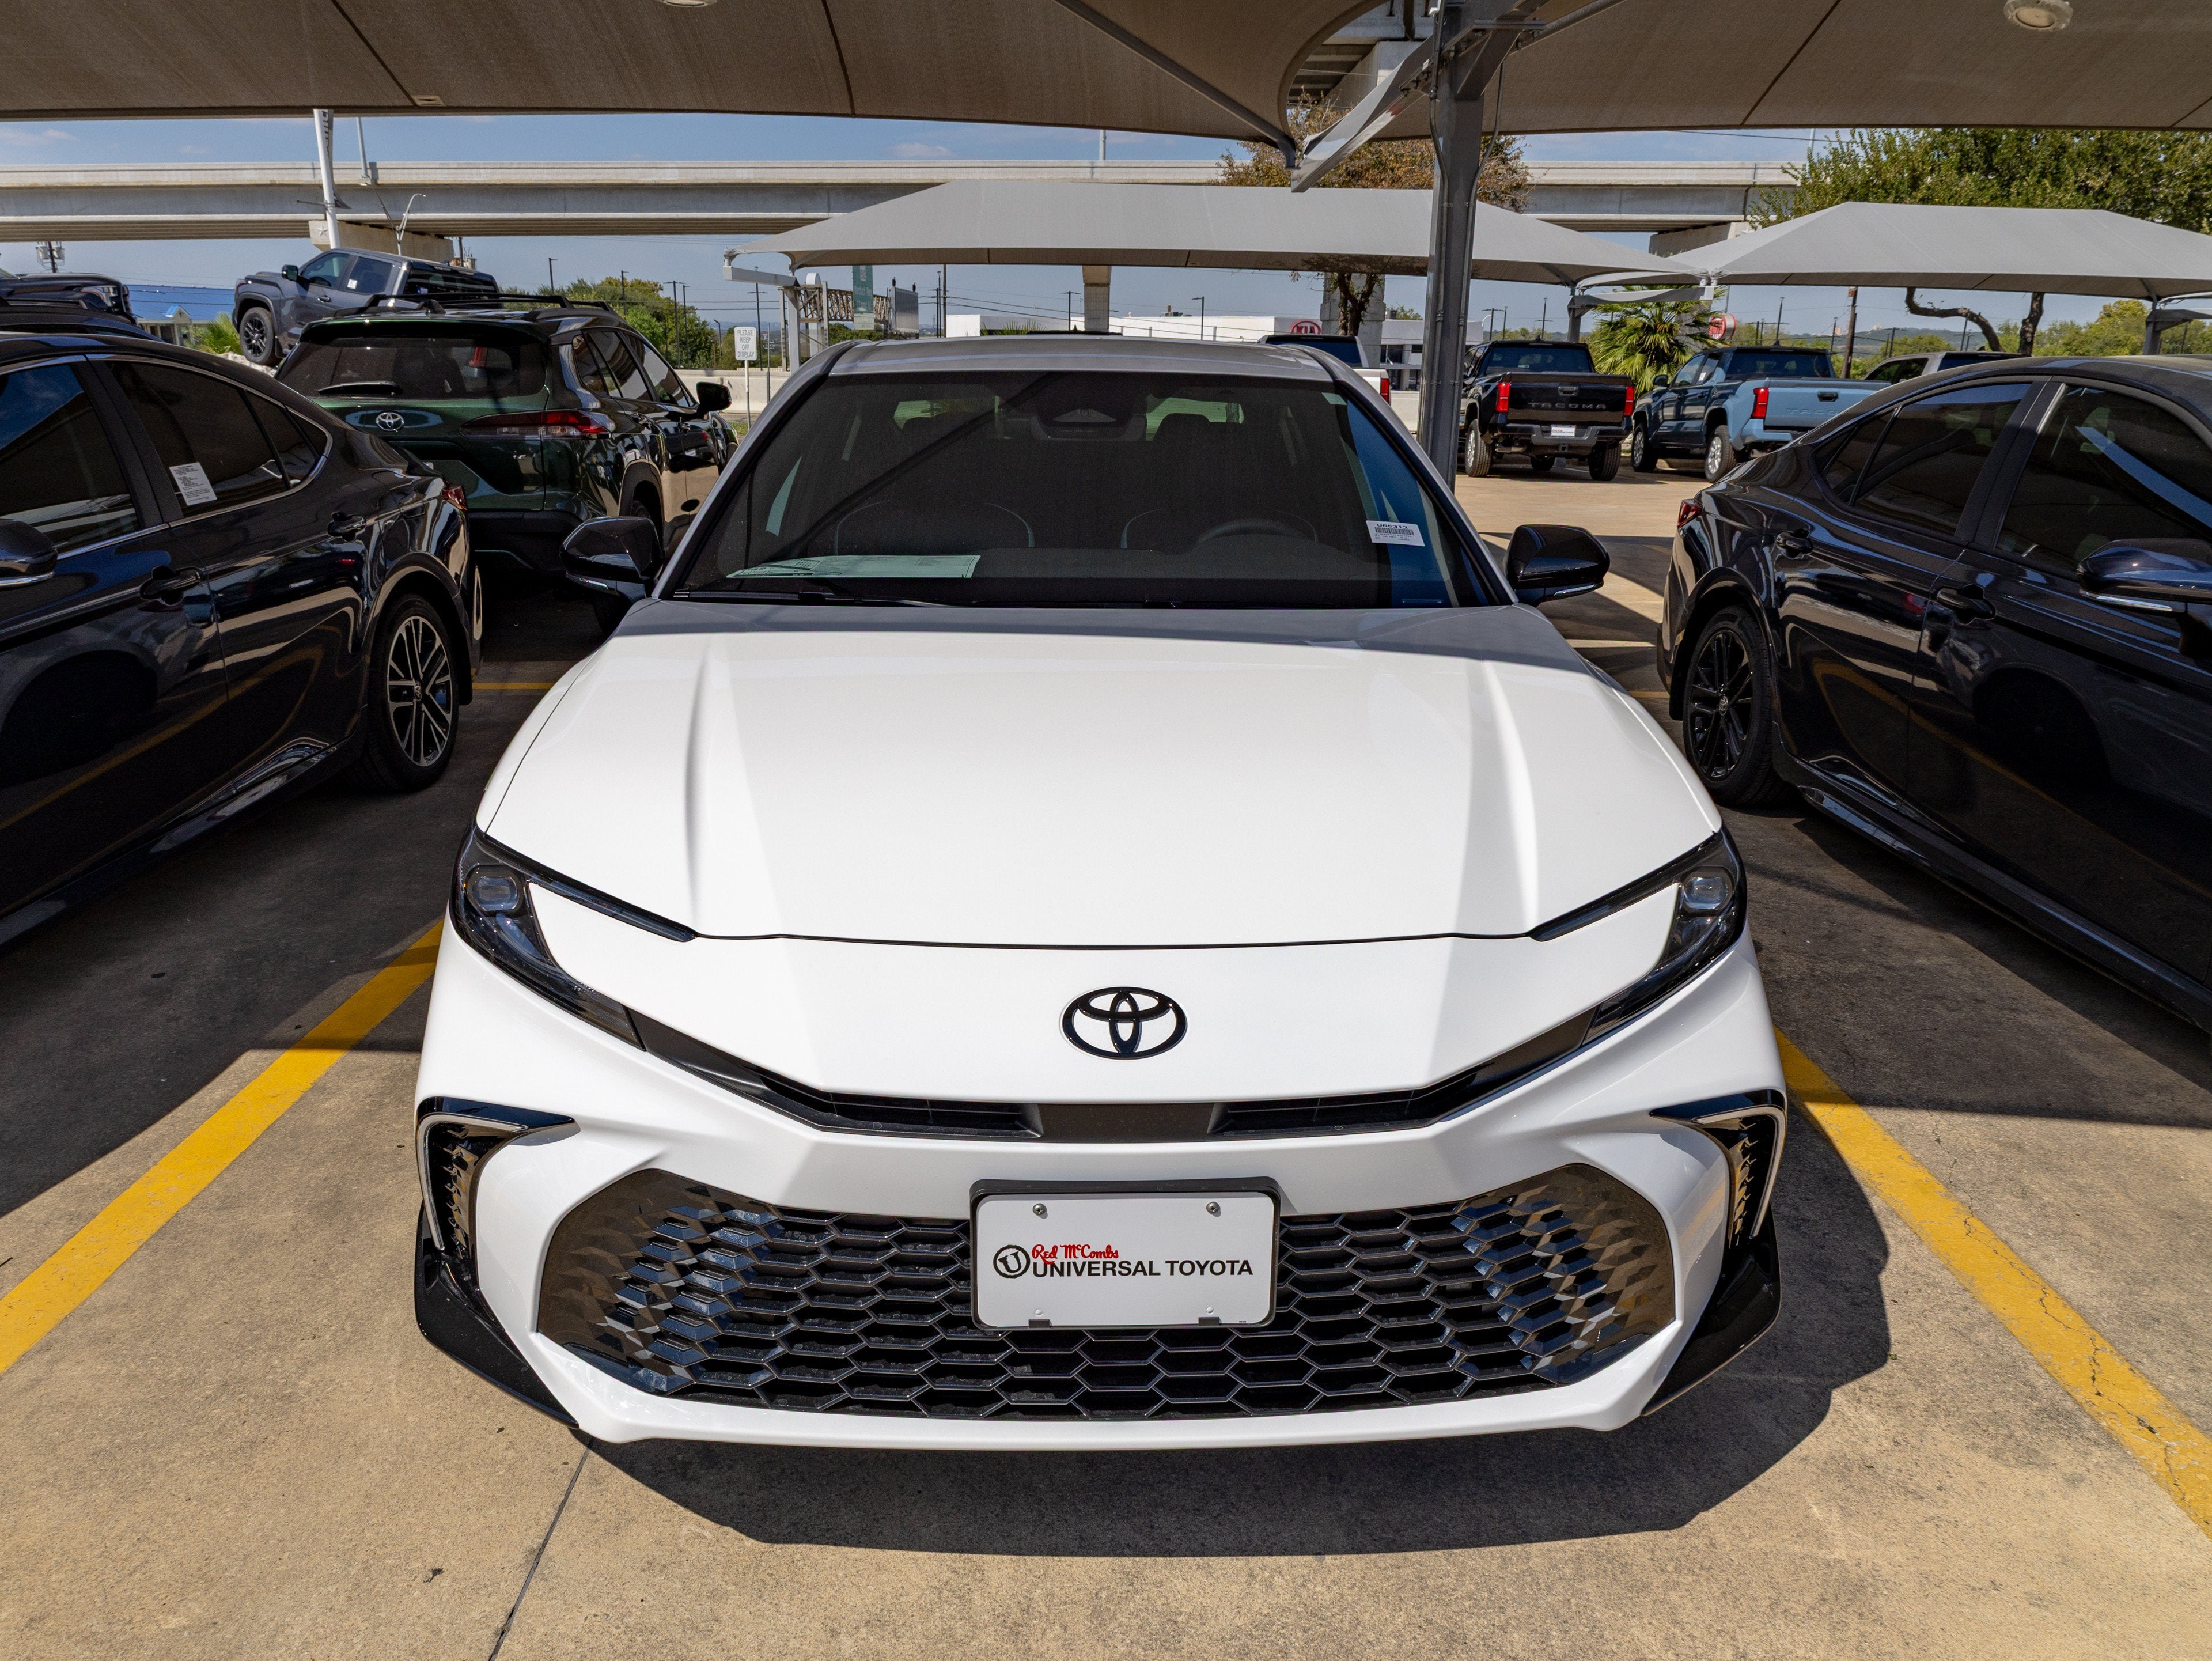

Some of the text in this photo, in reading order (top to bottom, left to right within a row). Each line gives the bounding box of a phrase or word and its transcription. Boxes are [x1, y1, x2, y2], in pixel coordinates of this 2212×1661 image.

[1296, 326, 1316, 334] KIA
[1032, 1244, 1119, 1265] Red McCombs
[1033, 1259, 1253, 1277] UNIVERSAL TOYOTA
